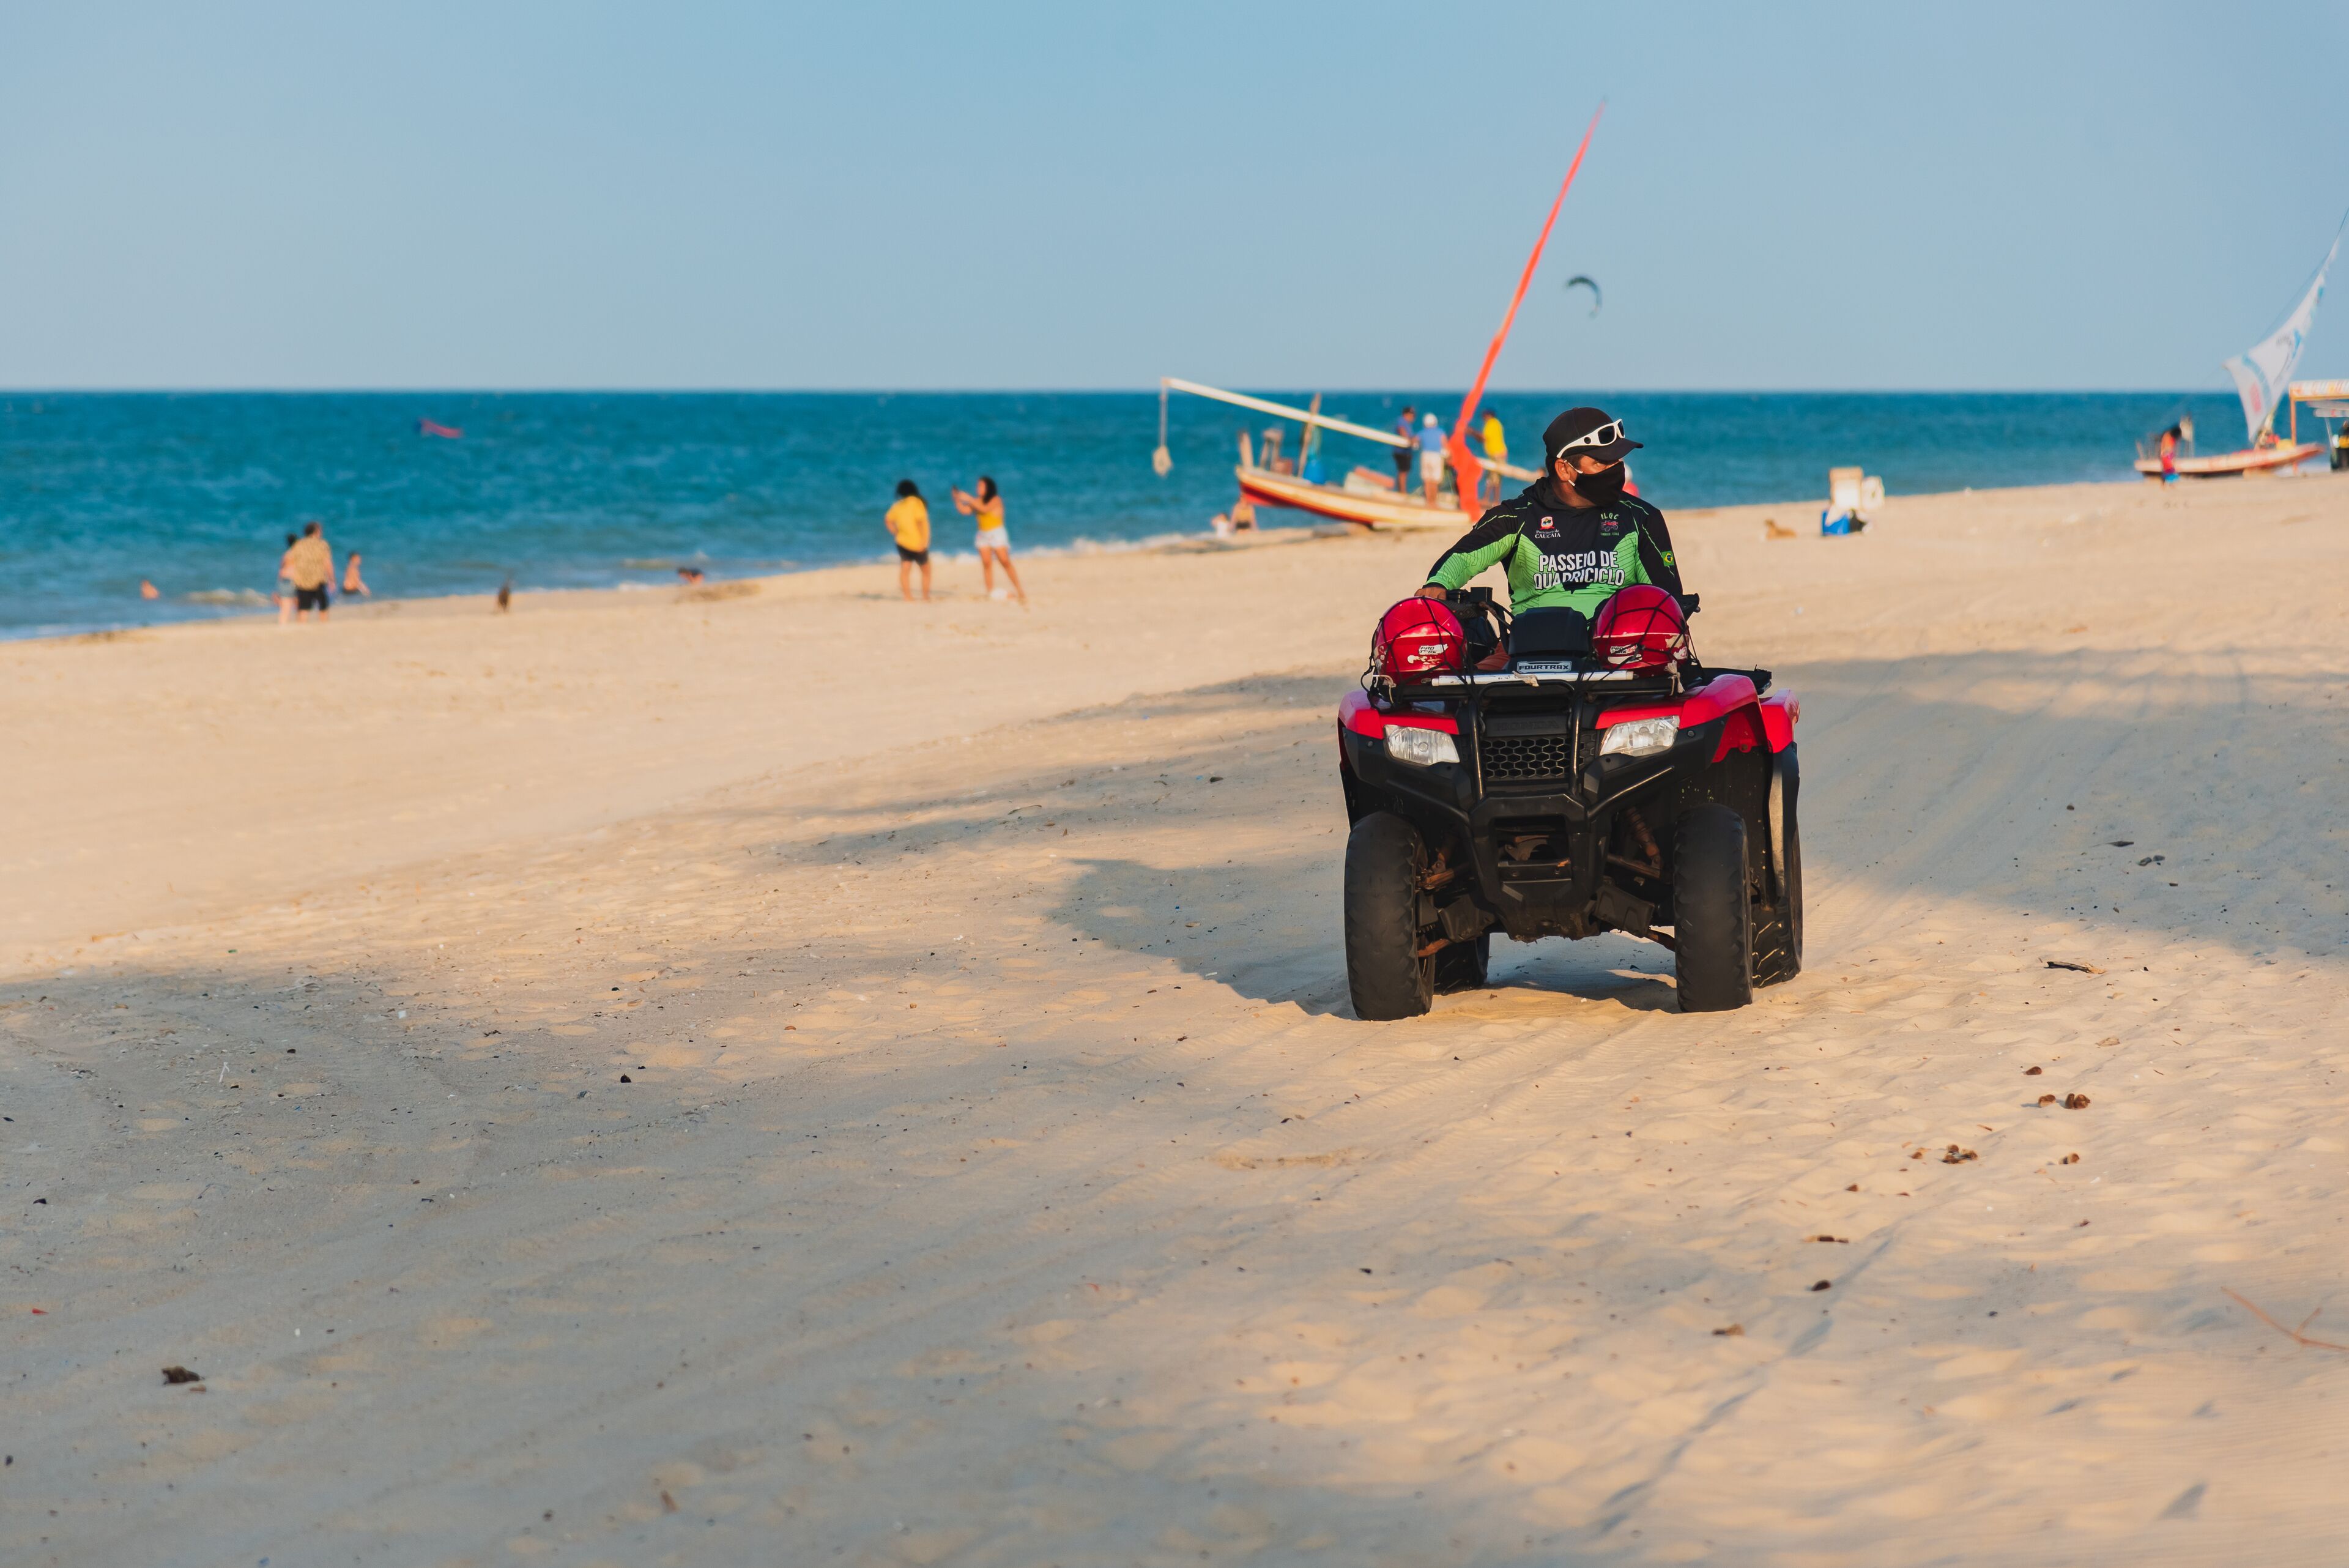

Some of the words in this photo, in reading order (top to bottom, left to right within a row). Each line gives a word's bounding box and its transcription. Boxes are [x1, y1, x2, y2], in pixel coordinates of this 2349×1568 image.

[1539, 551, 1596, 572] PASSEIO
[1600, 551, 1619, 568] DE
[1534, 567, 1625, 590] QUADRICICLO
[1496, 719, 1560, 731] HONDA
